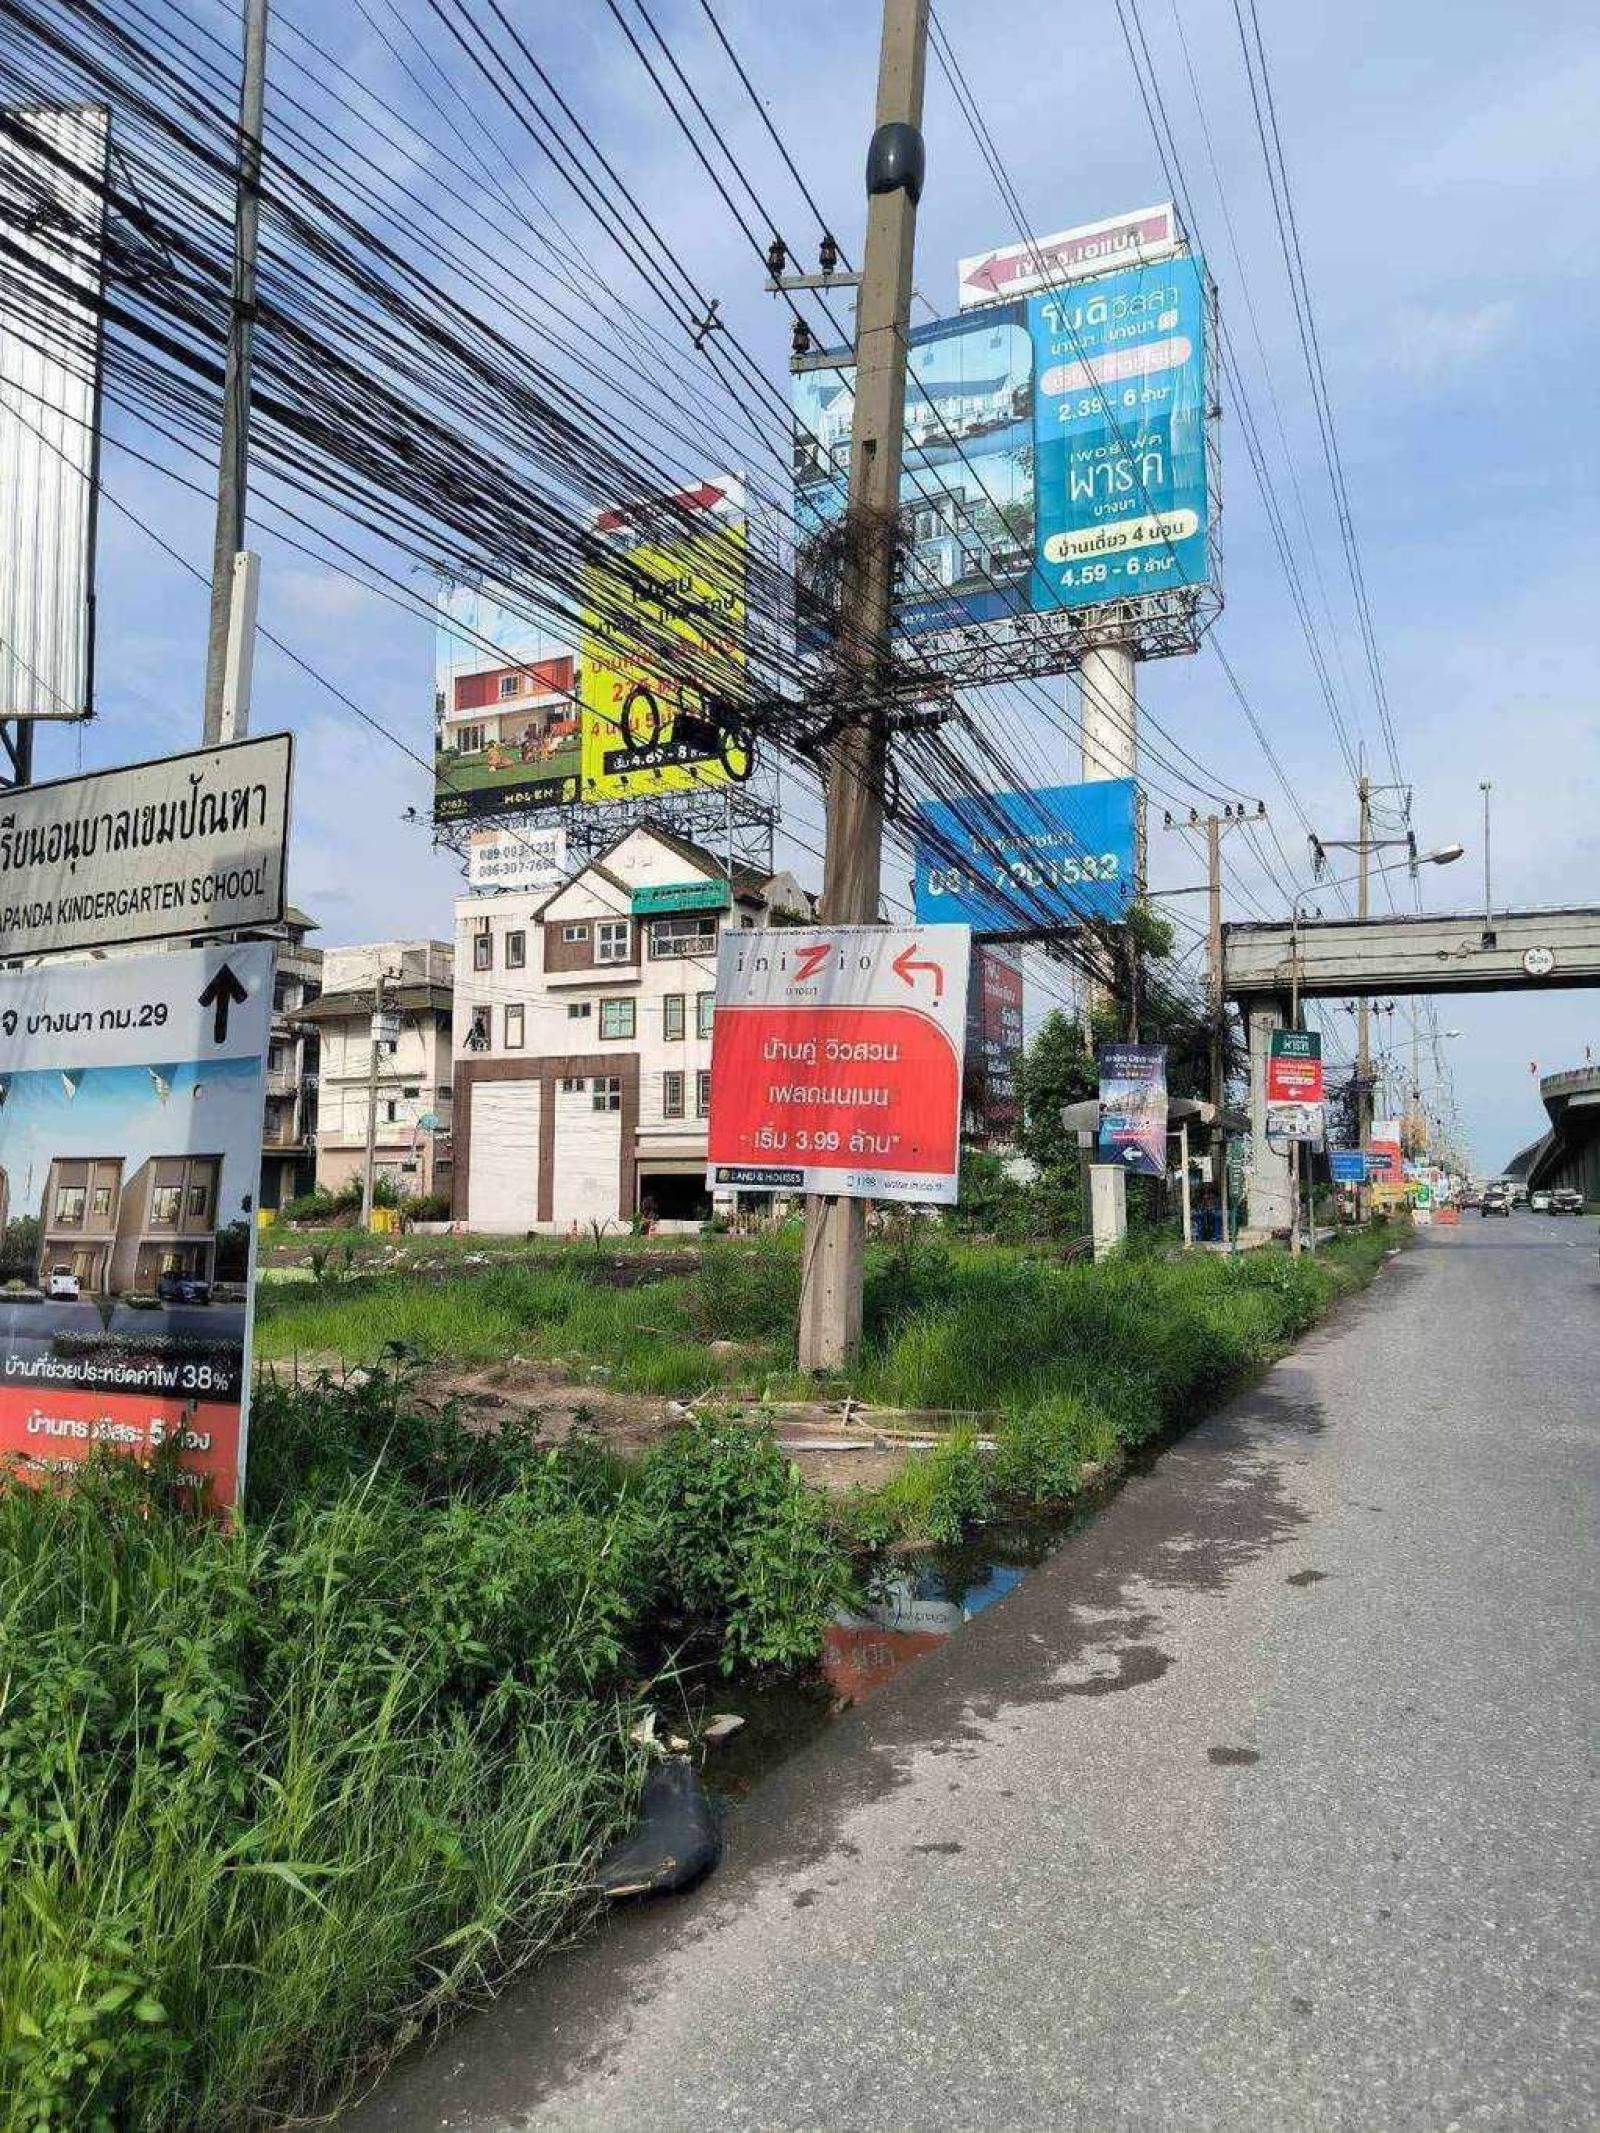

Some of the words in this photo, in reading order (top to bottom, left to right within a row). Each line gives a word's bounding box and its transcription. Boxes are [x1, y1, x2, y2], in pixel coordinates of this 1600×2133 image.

[1123, 388, 1136, 406] 6
[1132, 525, 1144, 542] 4
[1060, 562, 1107, 588] 4.59
[1126, 556, 1140, 575] 6
[0, 900, 53, 934] PANDA
[57, 880, 186, 925] KINDERGARTEN
[190, 868, 264, 905] SCHOOL
[27, 1012, 93, 1035] บางนา
[100, 1002, 169, 1031] กม.29
[763, 1037, 817, 1066] บ้านคู่
[796, 1130, 840, 1151] 3.99
